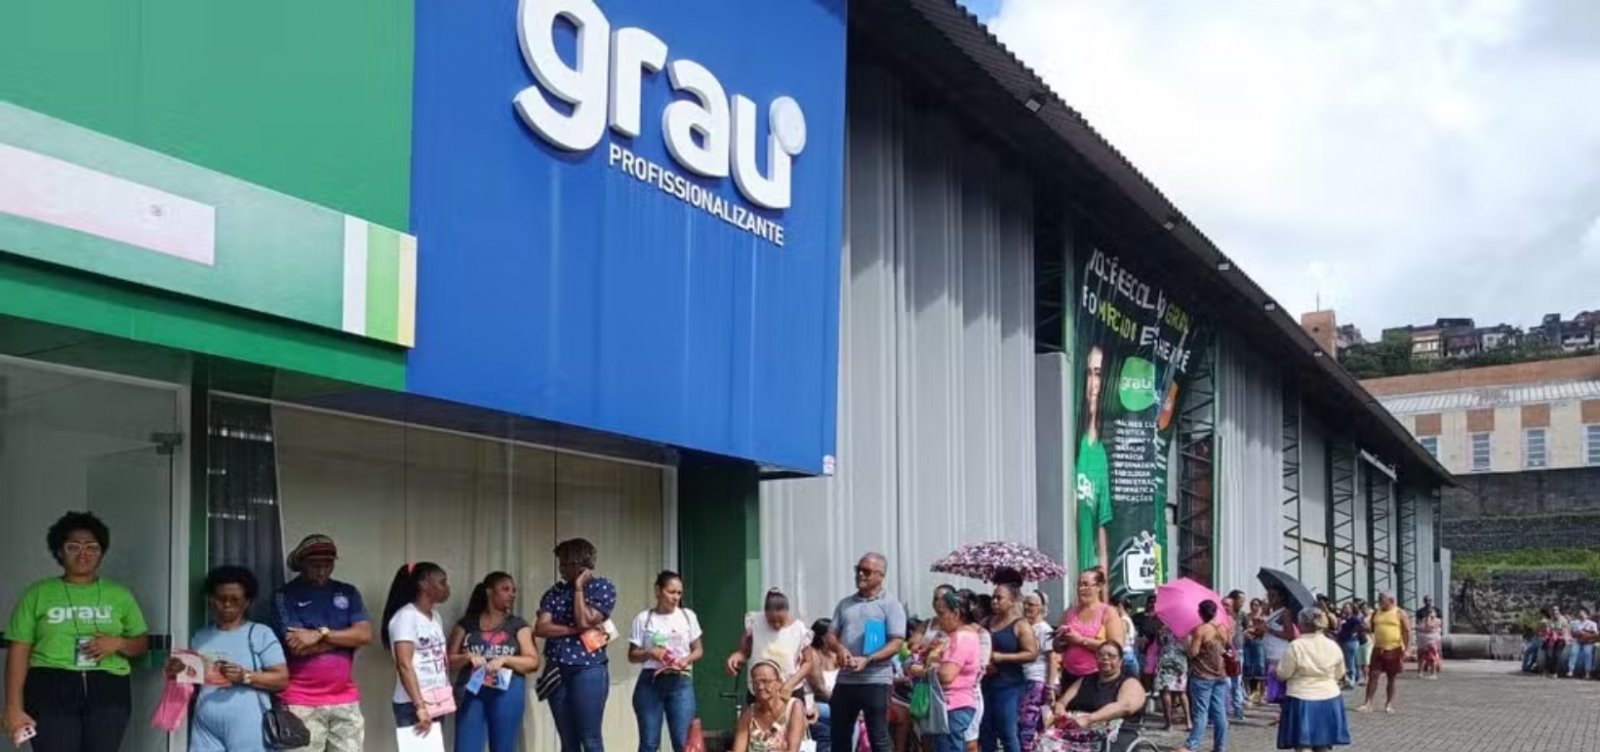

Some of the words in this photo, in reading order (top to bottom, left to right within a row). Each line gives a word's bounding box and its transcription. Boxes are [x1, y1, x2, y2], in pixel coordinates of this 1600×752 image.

[512, 0, 806, 209] grau
[608, 142, 785, 247] PROFISSIONALIZANTE
[48, 605, 112, 624] grau
